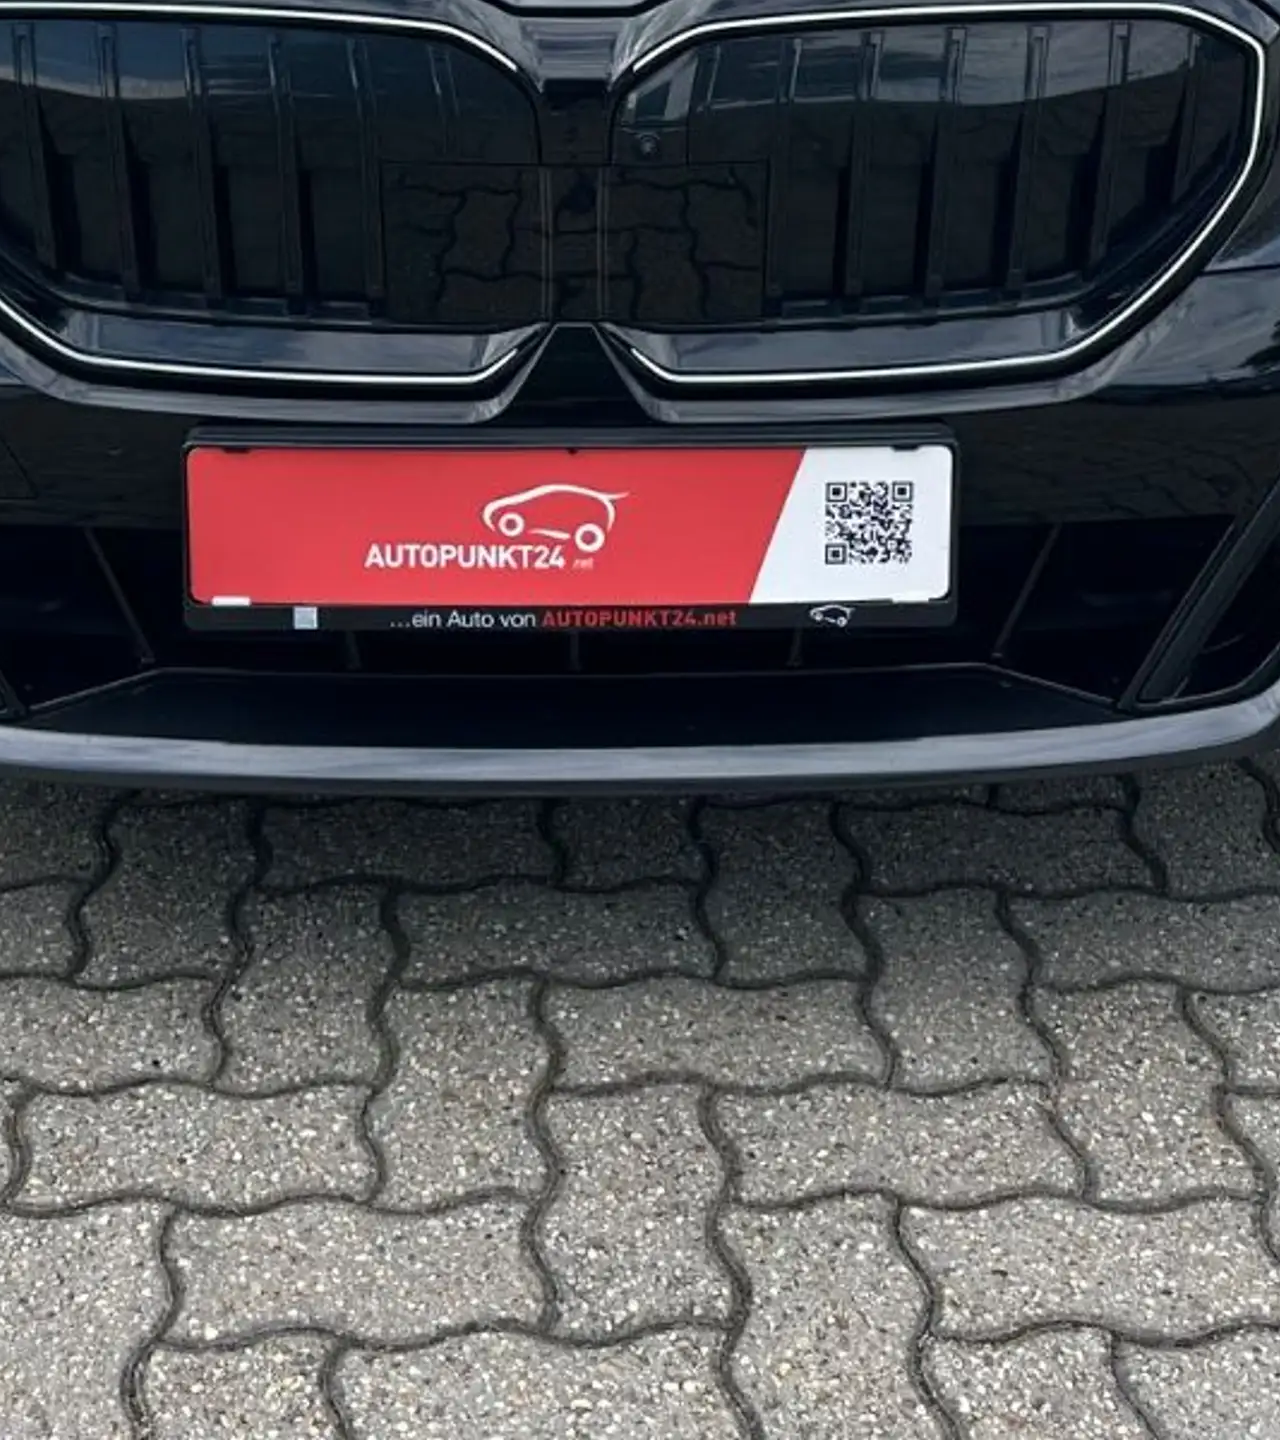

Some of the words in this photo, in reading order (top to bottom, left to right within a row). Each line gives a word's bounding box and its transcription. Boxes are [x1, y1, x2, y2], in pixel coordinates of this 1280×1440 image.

[364, 543, 565, 569] AUTOPUNKT24
[446, 610, 494, 628] Auto
[500, 613, 536, 628] von
[542, 610, 736, 627] AUTOPUNKT24.net
